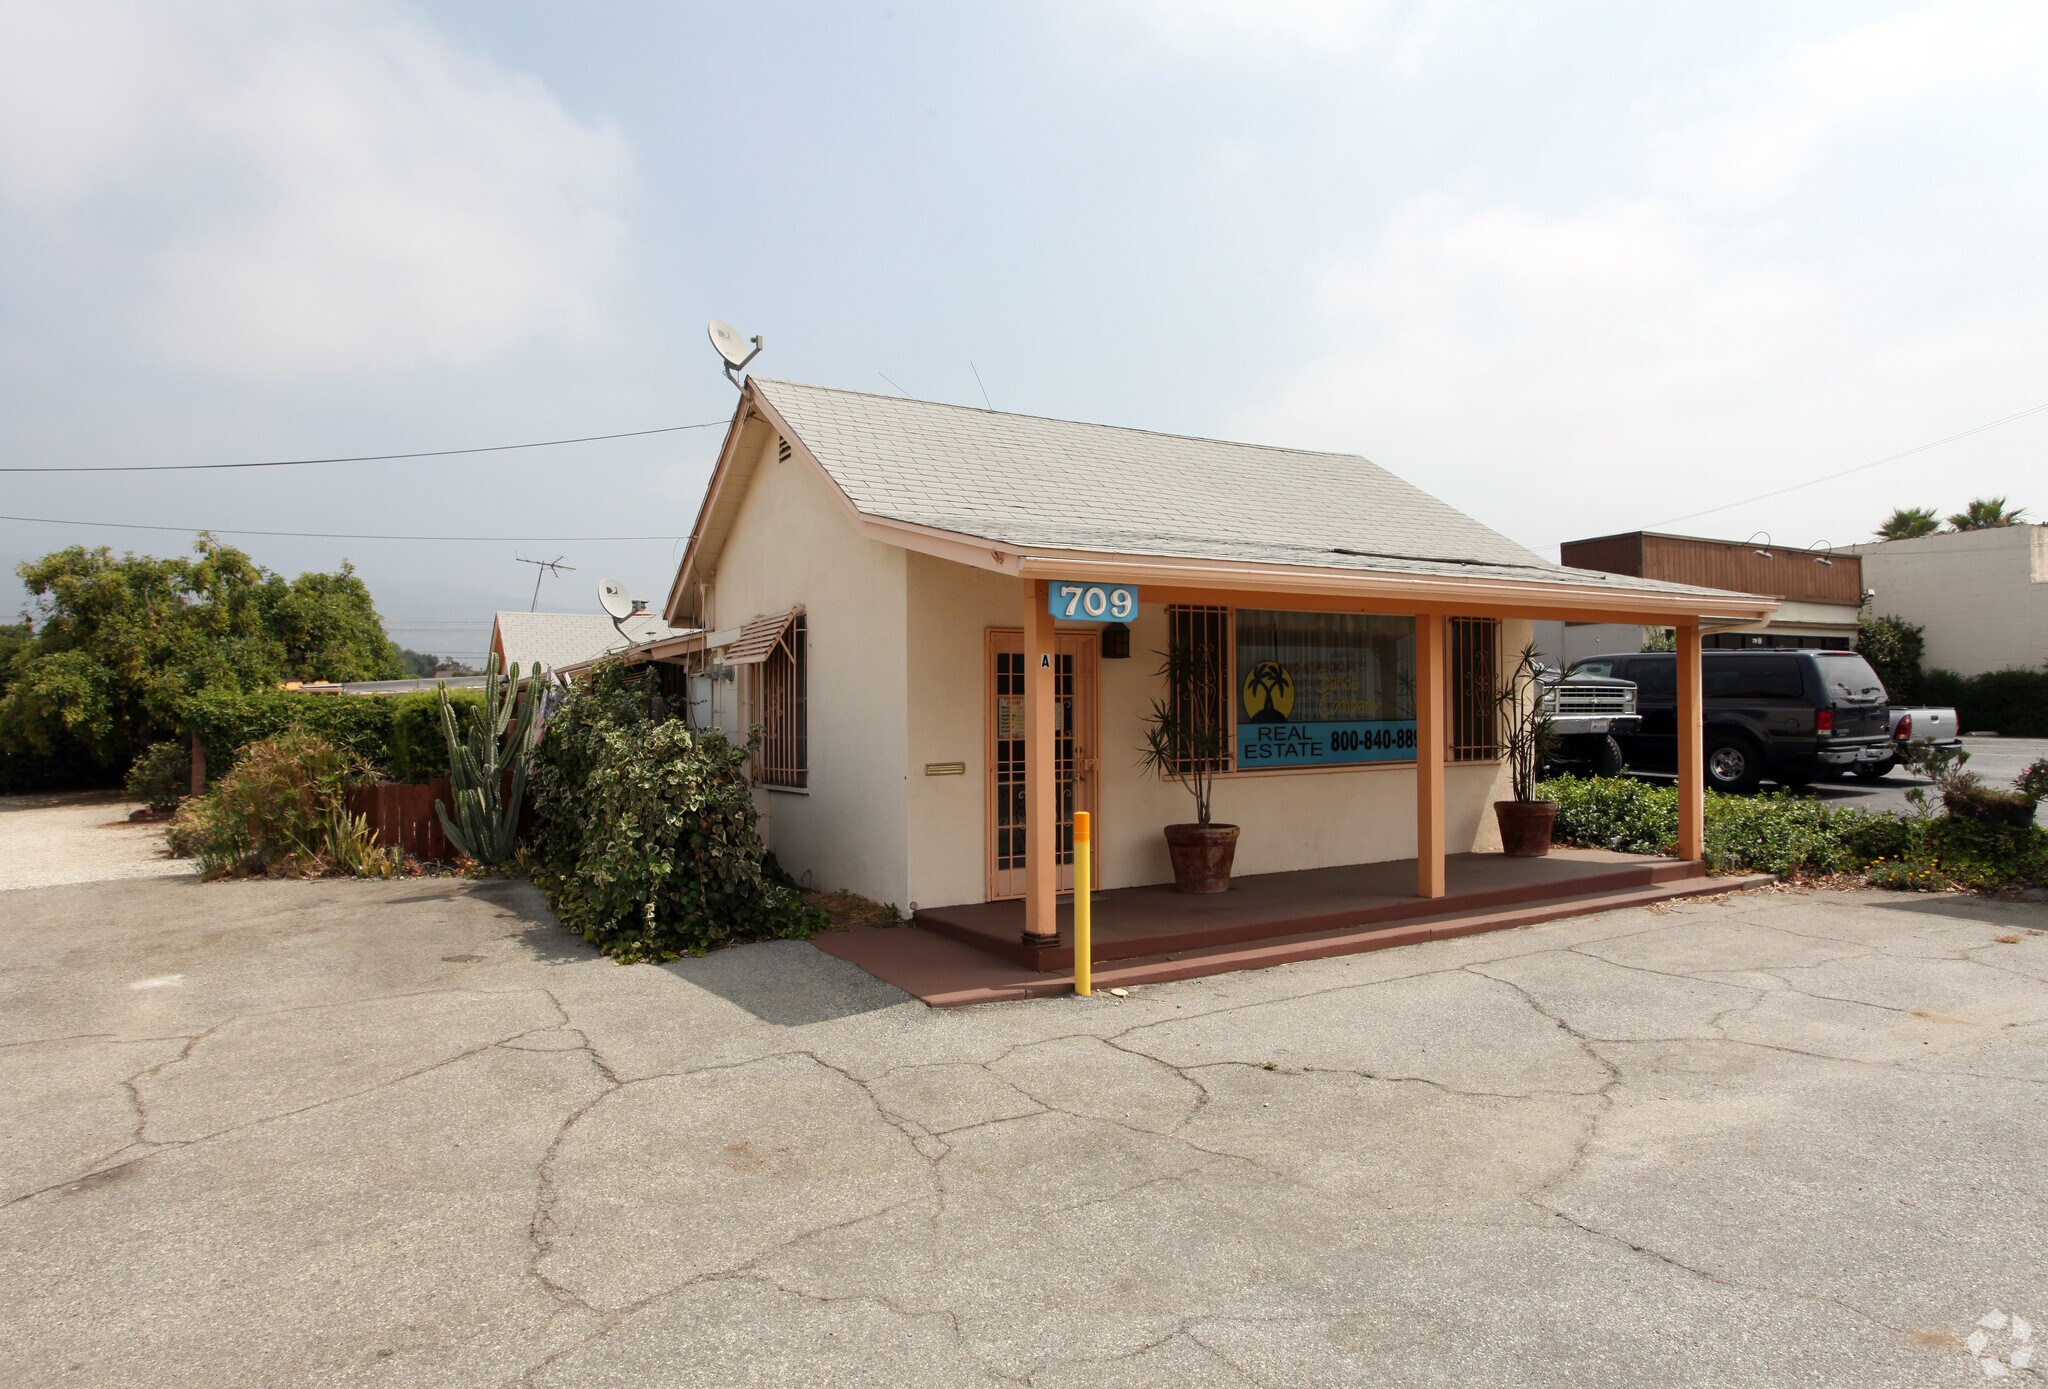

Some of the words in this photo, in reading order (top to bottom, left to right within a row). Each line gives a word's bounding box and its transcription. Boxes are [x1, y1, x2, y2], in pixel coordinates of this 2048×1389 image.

[1061, 586, 1132, 618] 709
[1041, 654, 1050, 668] A
[1318, 690, 1380, 719] Company
[1258, 726, 1313, 742] REAL
[1244, 742, 1323, 759] ESTATE
